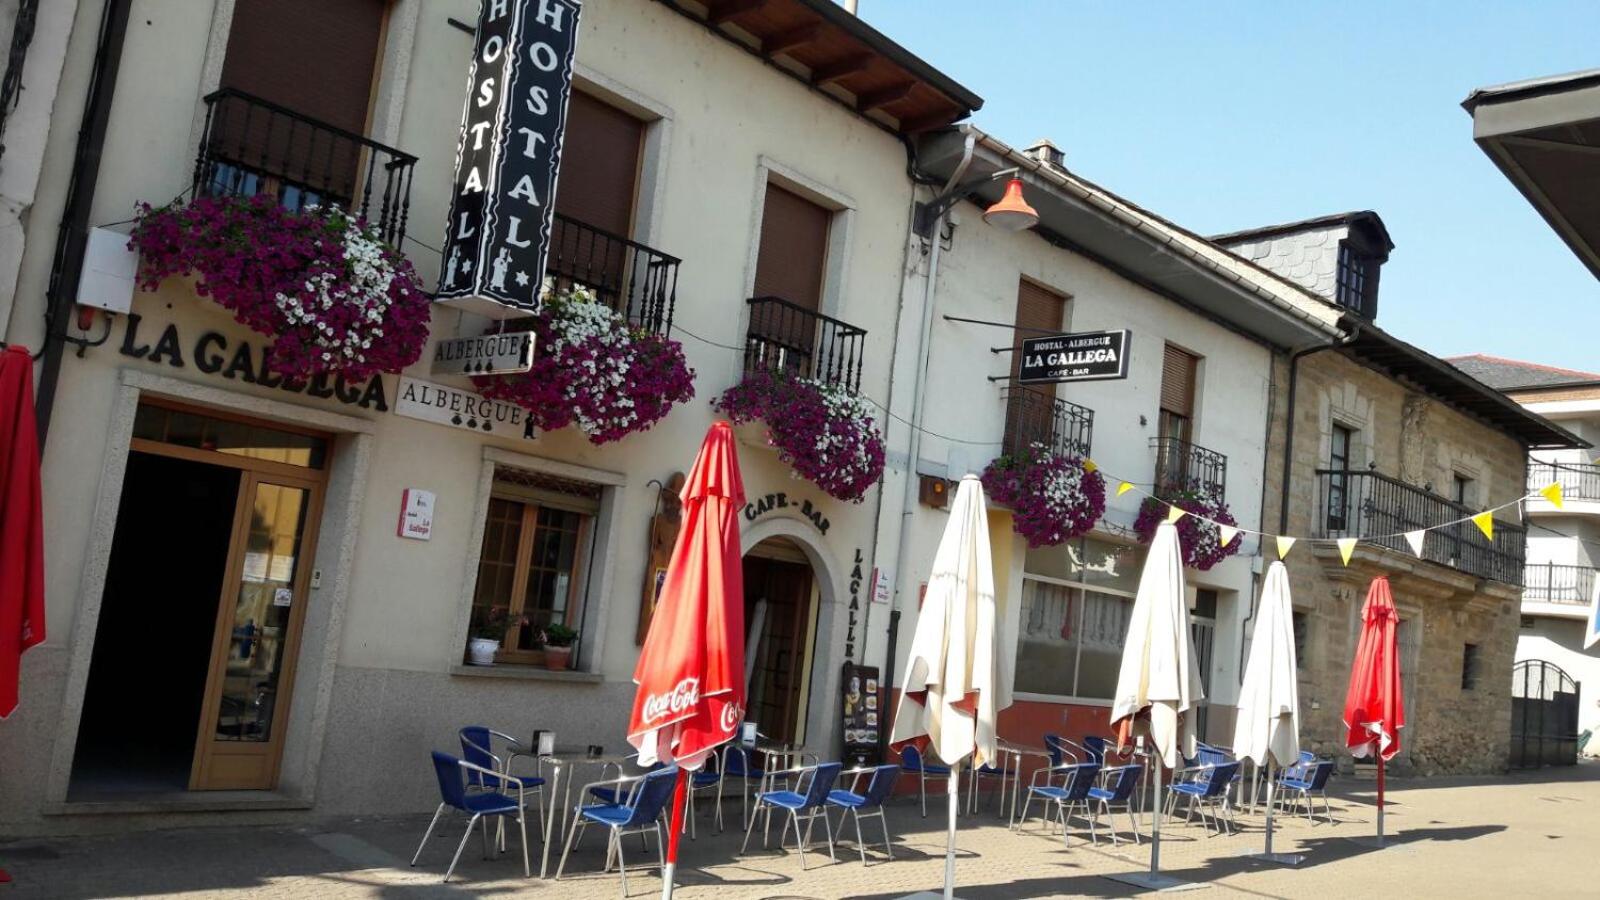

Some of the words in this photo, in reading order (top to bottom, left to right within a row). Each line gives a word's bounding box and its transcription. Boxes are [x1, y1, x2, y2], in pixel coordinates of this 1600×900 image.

[457, 0, 508, 239] HOSTAL
[505, 0, 566, 248] HOSTAL
[119, 313, 184, 368] LA
[434, 336, 520, 362] ALBERGUE
[1025, 355, 1043, 367] LA
[1047, 348, 1116, 365] GALLEGA
[402, 383, 522, 425] ALBERGUE
[642, 677, 700, 724] Coca-Col
